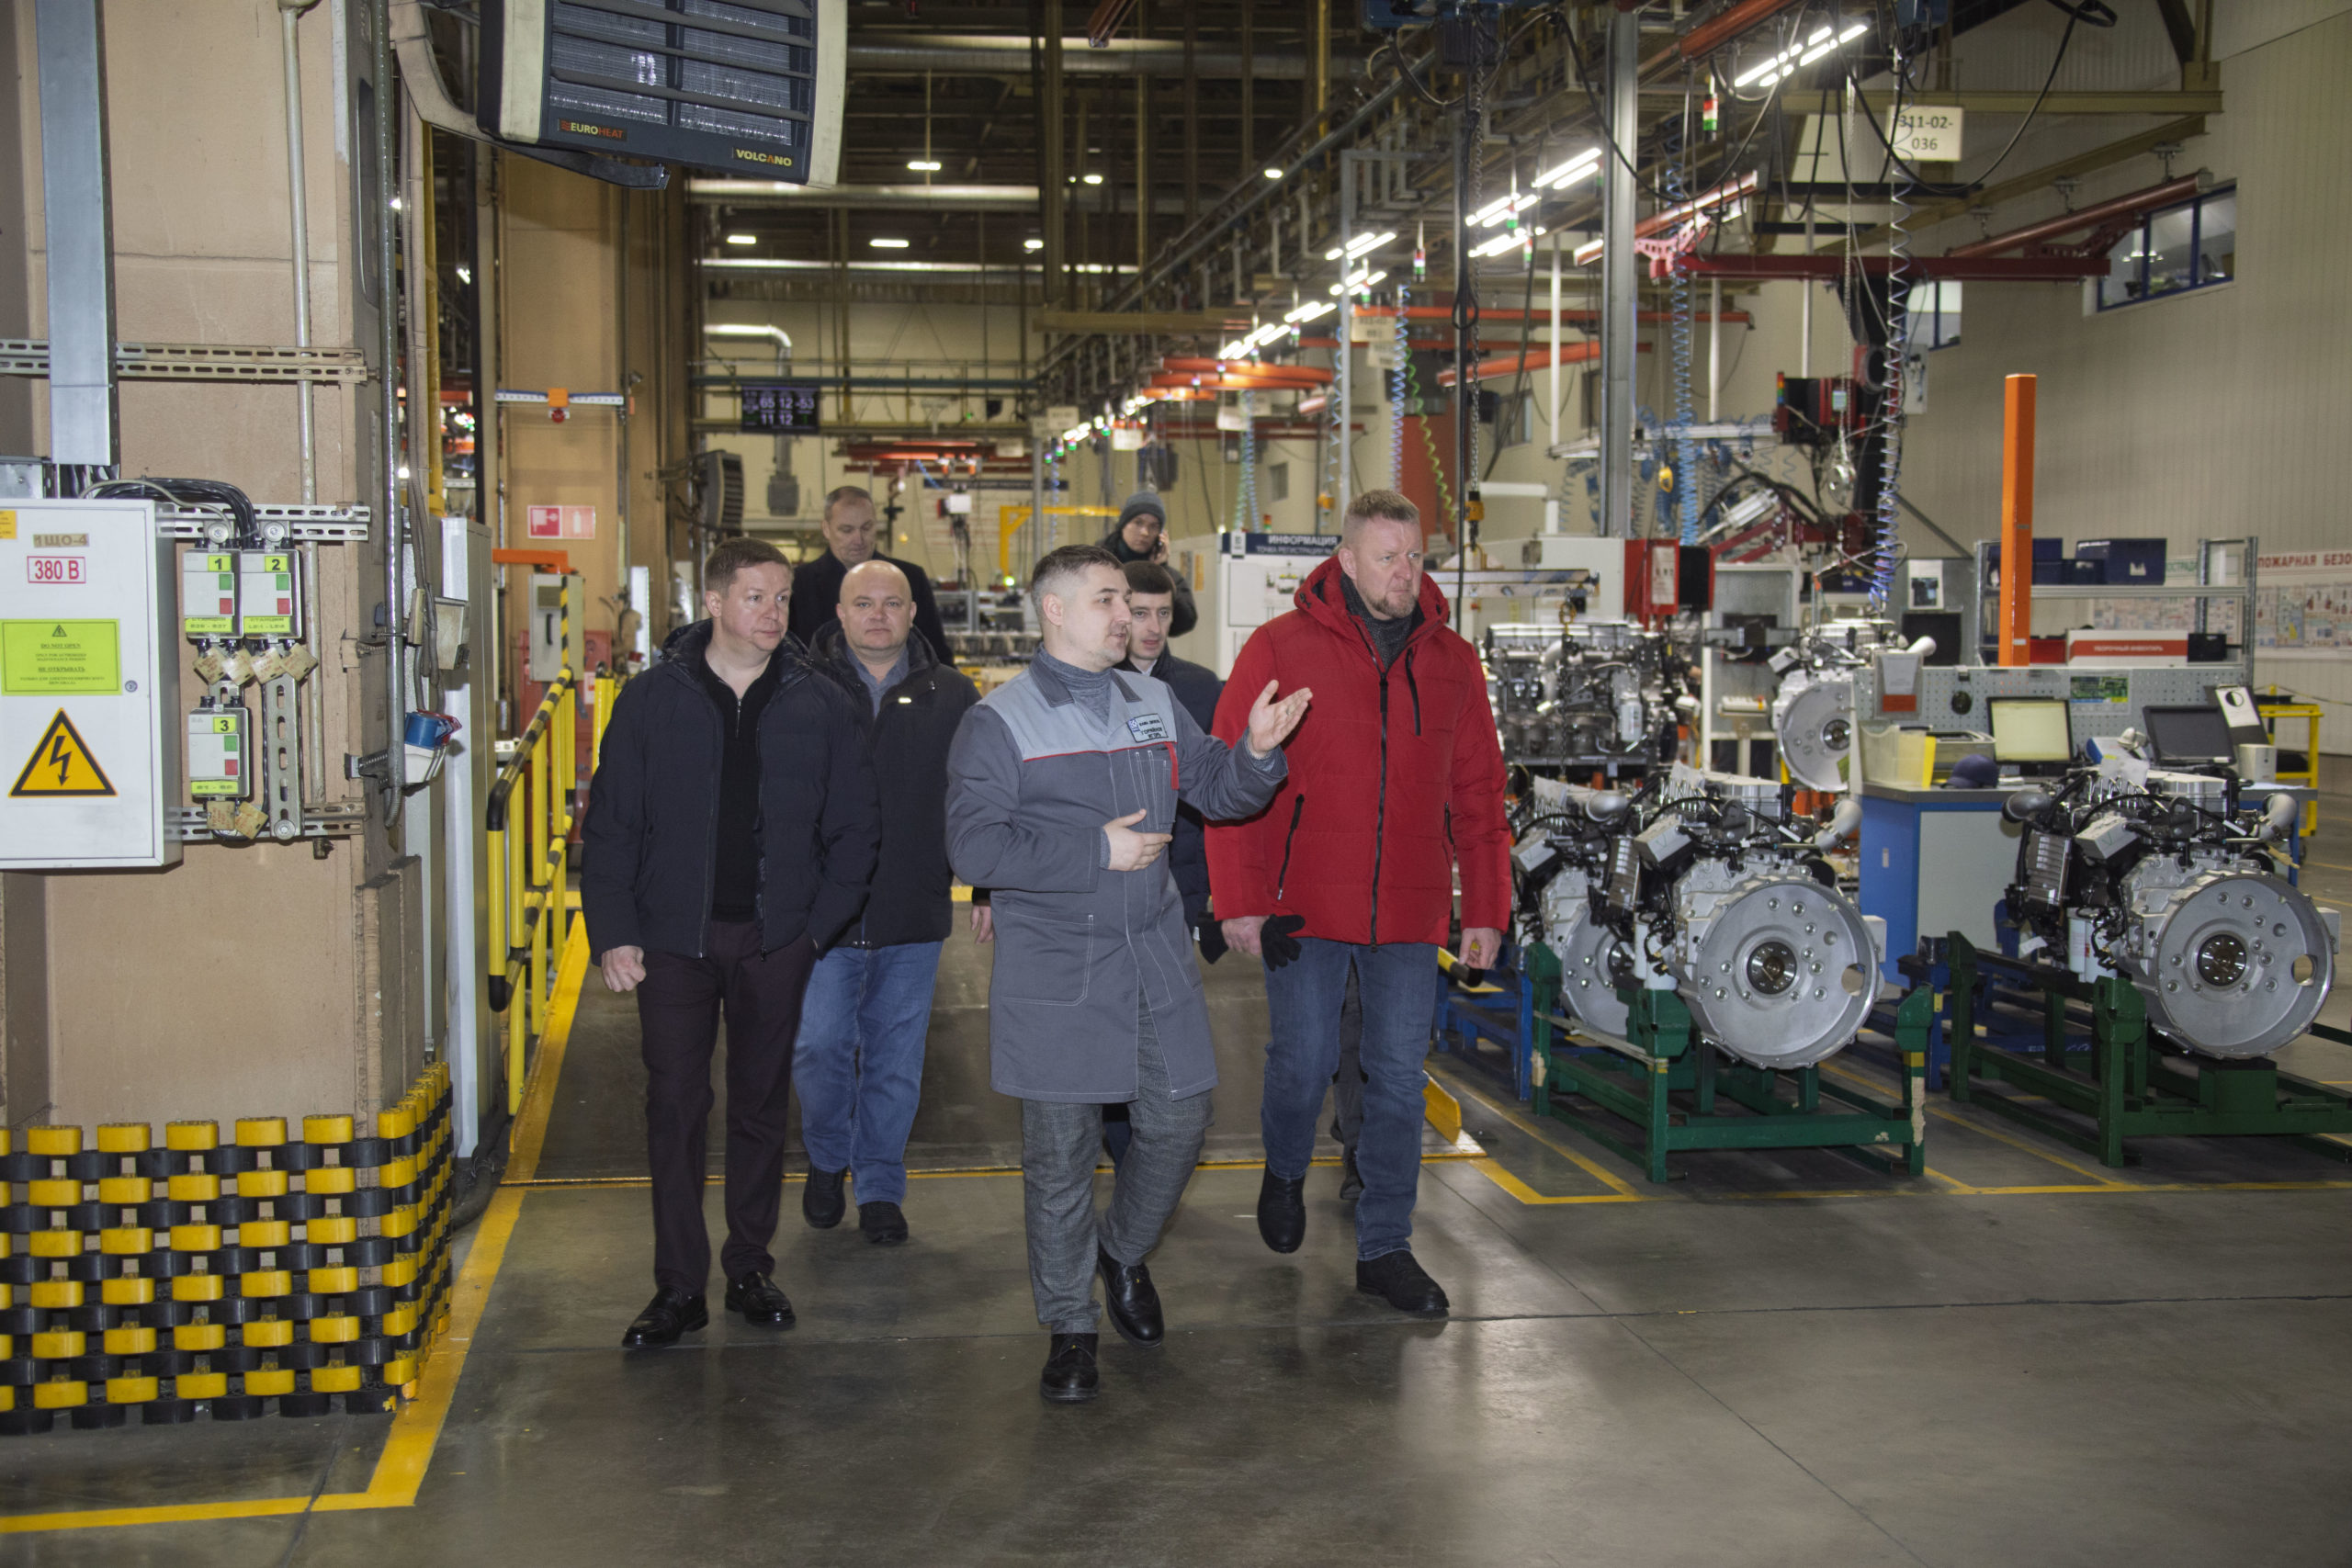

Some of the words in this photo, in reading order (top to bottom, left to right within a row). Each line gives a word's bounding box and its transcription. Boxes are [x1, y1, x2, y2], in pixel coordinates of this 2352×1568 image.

[570, 122, 624, 139] EUROHEAT
[1911, 137, 1938, 150] 036
[736, 148, 792, 166] VOLCANO
[779, 397, 793, 409] 12
[761, 413, 774, 425] 11
[779, 413, 793, 425] 12
[1268, 535, 1338, 546] ИНФОРМАЦИЯ
[214, 558, 222, 570] 1
[271, 558, 280, 570] 2
[2257, 554, 2317, 568] ПОЖАРНАЯ
[35, 559, 62, 580] 380
[220, 719, 229, 732] 3
